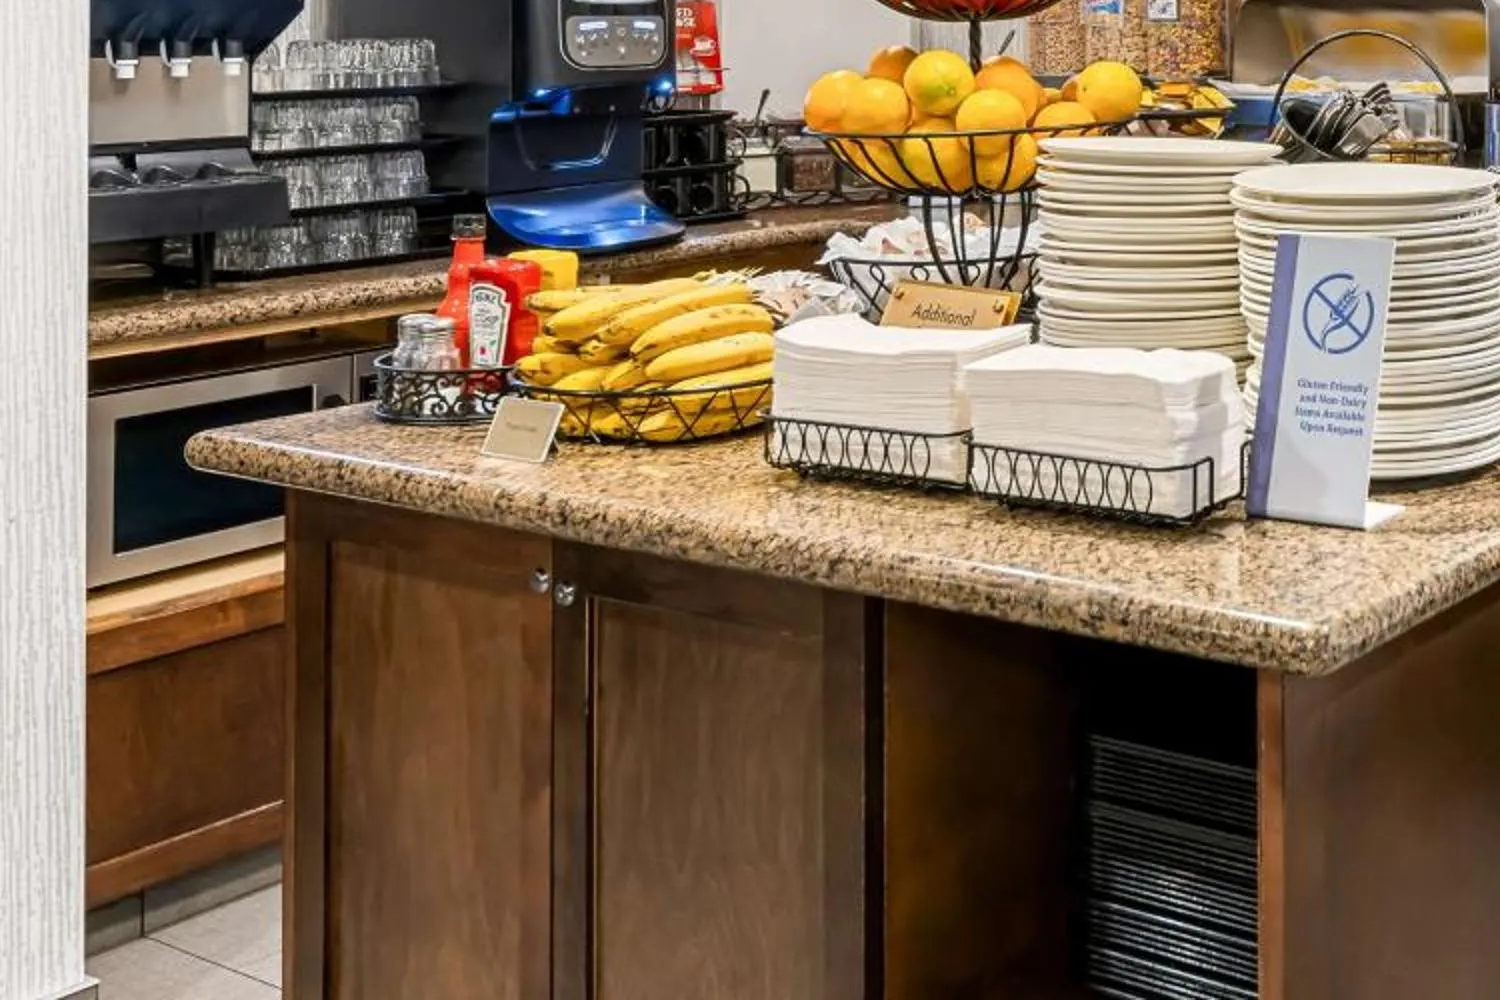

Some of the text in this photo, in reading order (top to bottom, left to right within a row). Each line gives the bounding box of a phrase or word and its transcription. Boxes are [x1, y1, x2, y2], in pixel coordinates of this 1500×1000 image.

[911, 302, 977, 326] Additional
[1329, 380, 1369, 396] Friendly
[1300, 393, 1317, 403] and
[1322, 408, 1366, 422] Available
[1300, 420, 1364, 437] Upon Request
